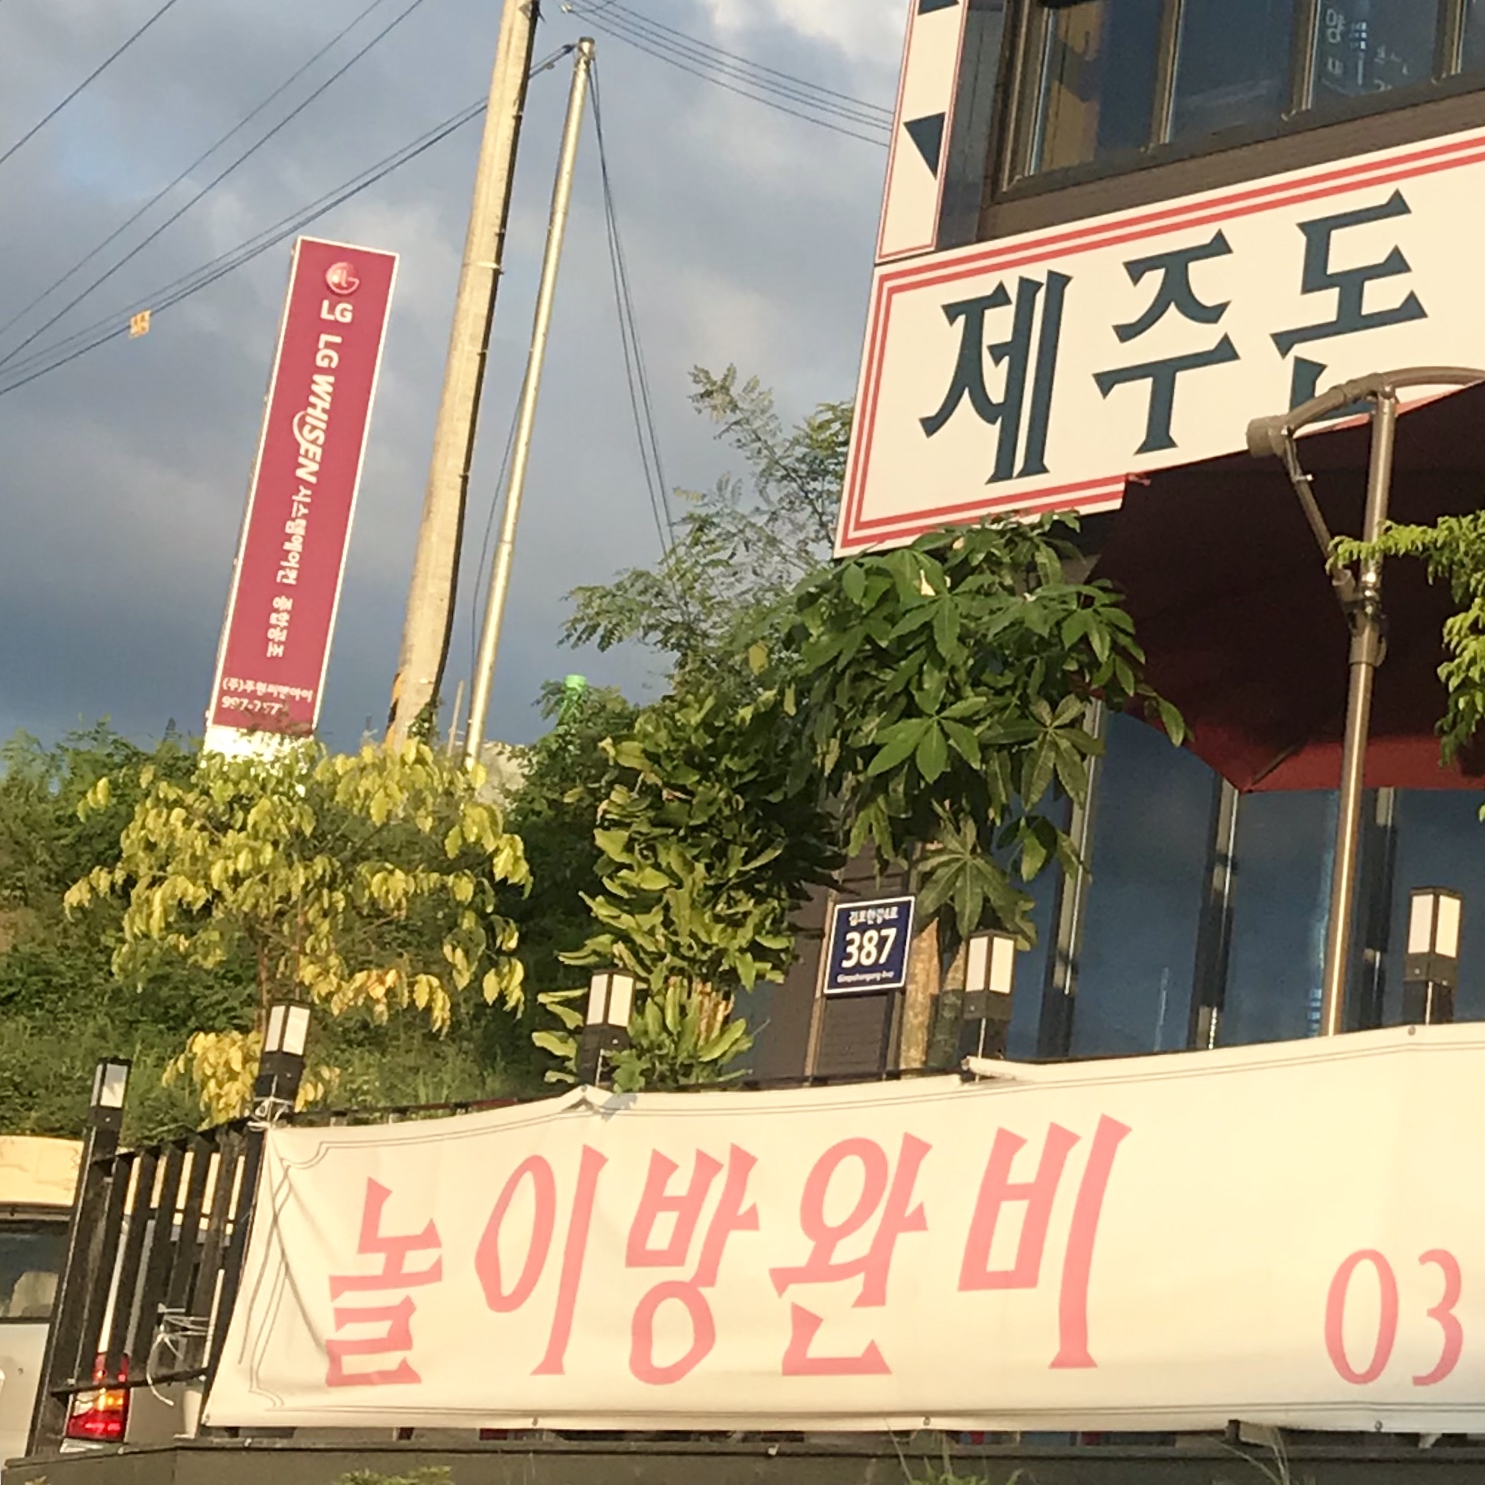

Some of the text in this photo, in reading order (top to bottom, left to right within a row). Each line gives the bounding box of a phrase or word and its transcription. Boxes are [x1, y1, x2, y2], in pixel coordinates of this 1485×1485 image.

[320, 299, 353, 323] LG
[315, 333, 343, 369] LG
[293, 374, 335, 484] WHISEN
[841, 927, 897, 968] 387
[326, 1116, 1129, 1387] 놀이방완비
